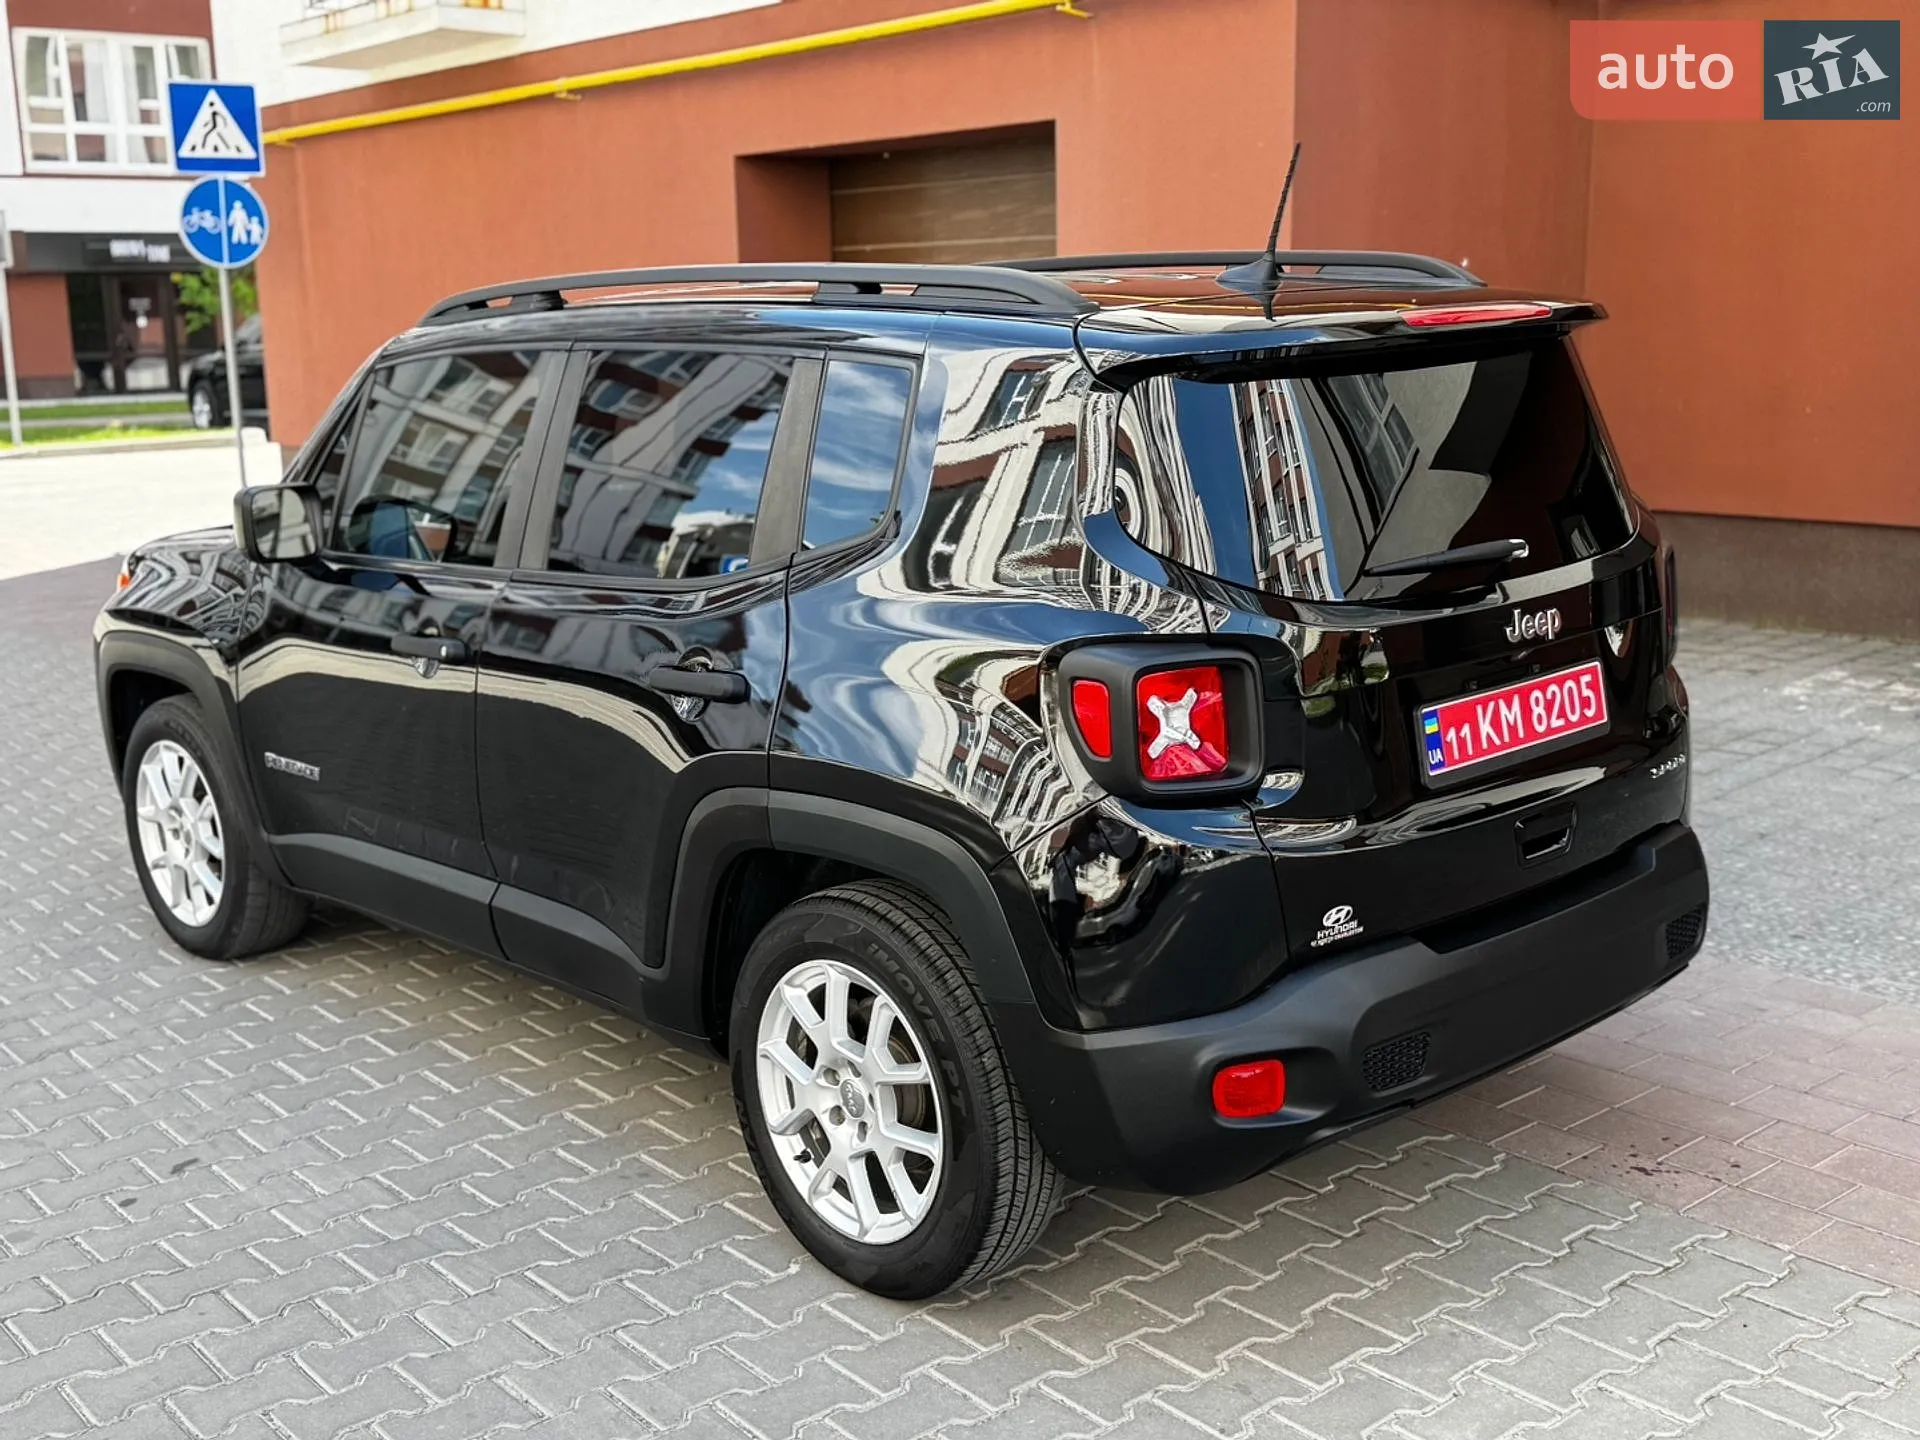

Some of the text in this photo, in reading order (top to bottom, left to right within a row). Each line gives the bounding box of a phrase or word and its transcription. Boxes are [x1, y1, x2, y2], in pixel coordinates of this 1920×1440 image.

[1504, 607, 1562, 644] Jeep
[1445, 674, 1597, 760] 11 KM 8205
[1428, 748, 1443, 765] UA
[1317, 919, 1358, 940] HYUNDAI
